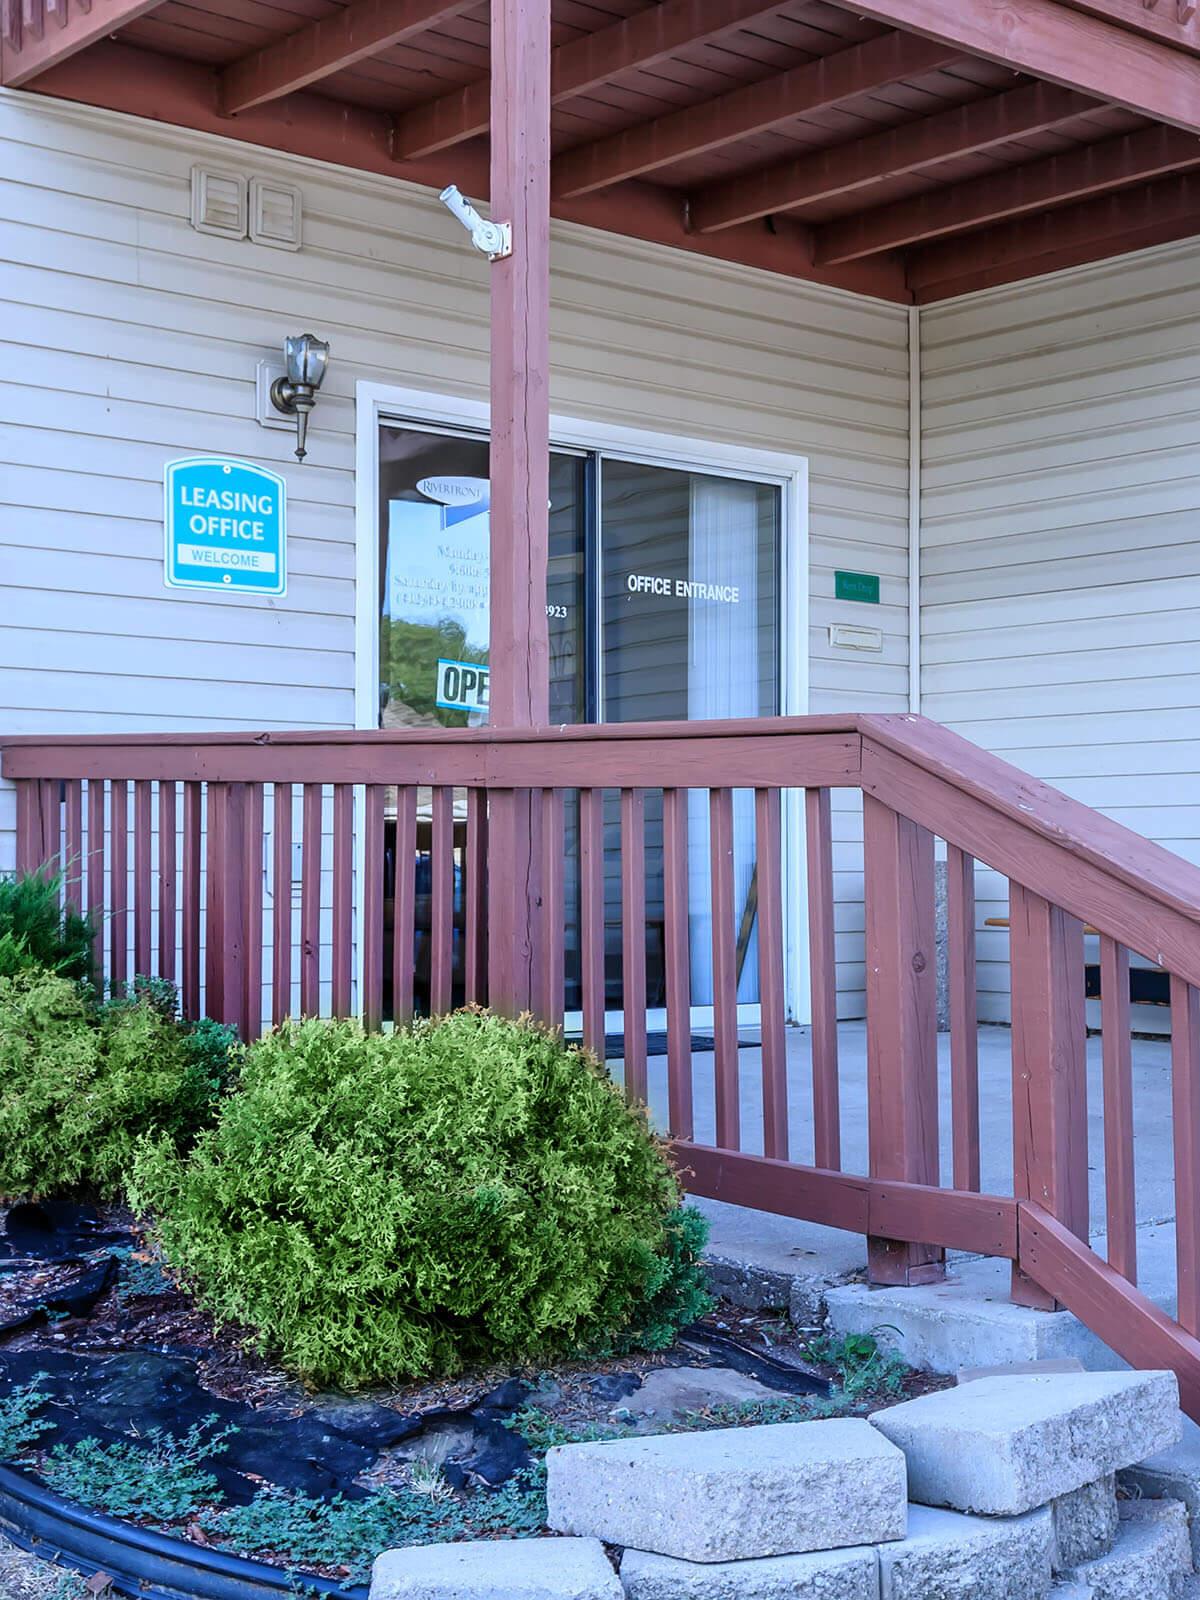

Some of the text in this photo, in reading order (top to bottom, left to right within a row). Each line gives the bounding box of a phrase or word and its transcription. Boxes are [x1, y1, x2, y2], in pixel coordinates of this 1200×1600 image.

[181, 485, 273, 515] LEASING
[189, 514, 265, 541] OFFICE
[191, 549, 260, 568] WELCOME
[627, 574, 740, 603] OFFICE ENTRANCE
[443, 666, 489, 705] OPE
